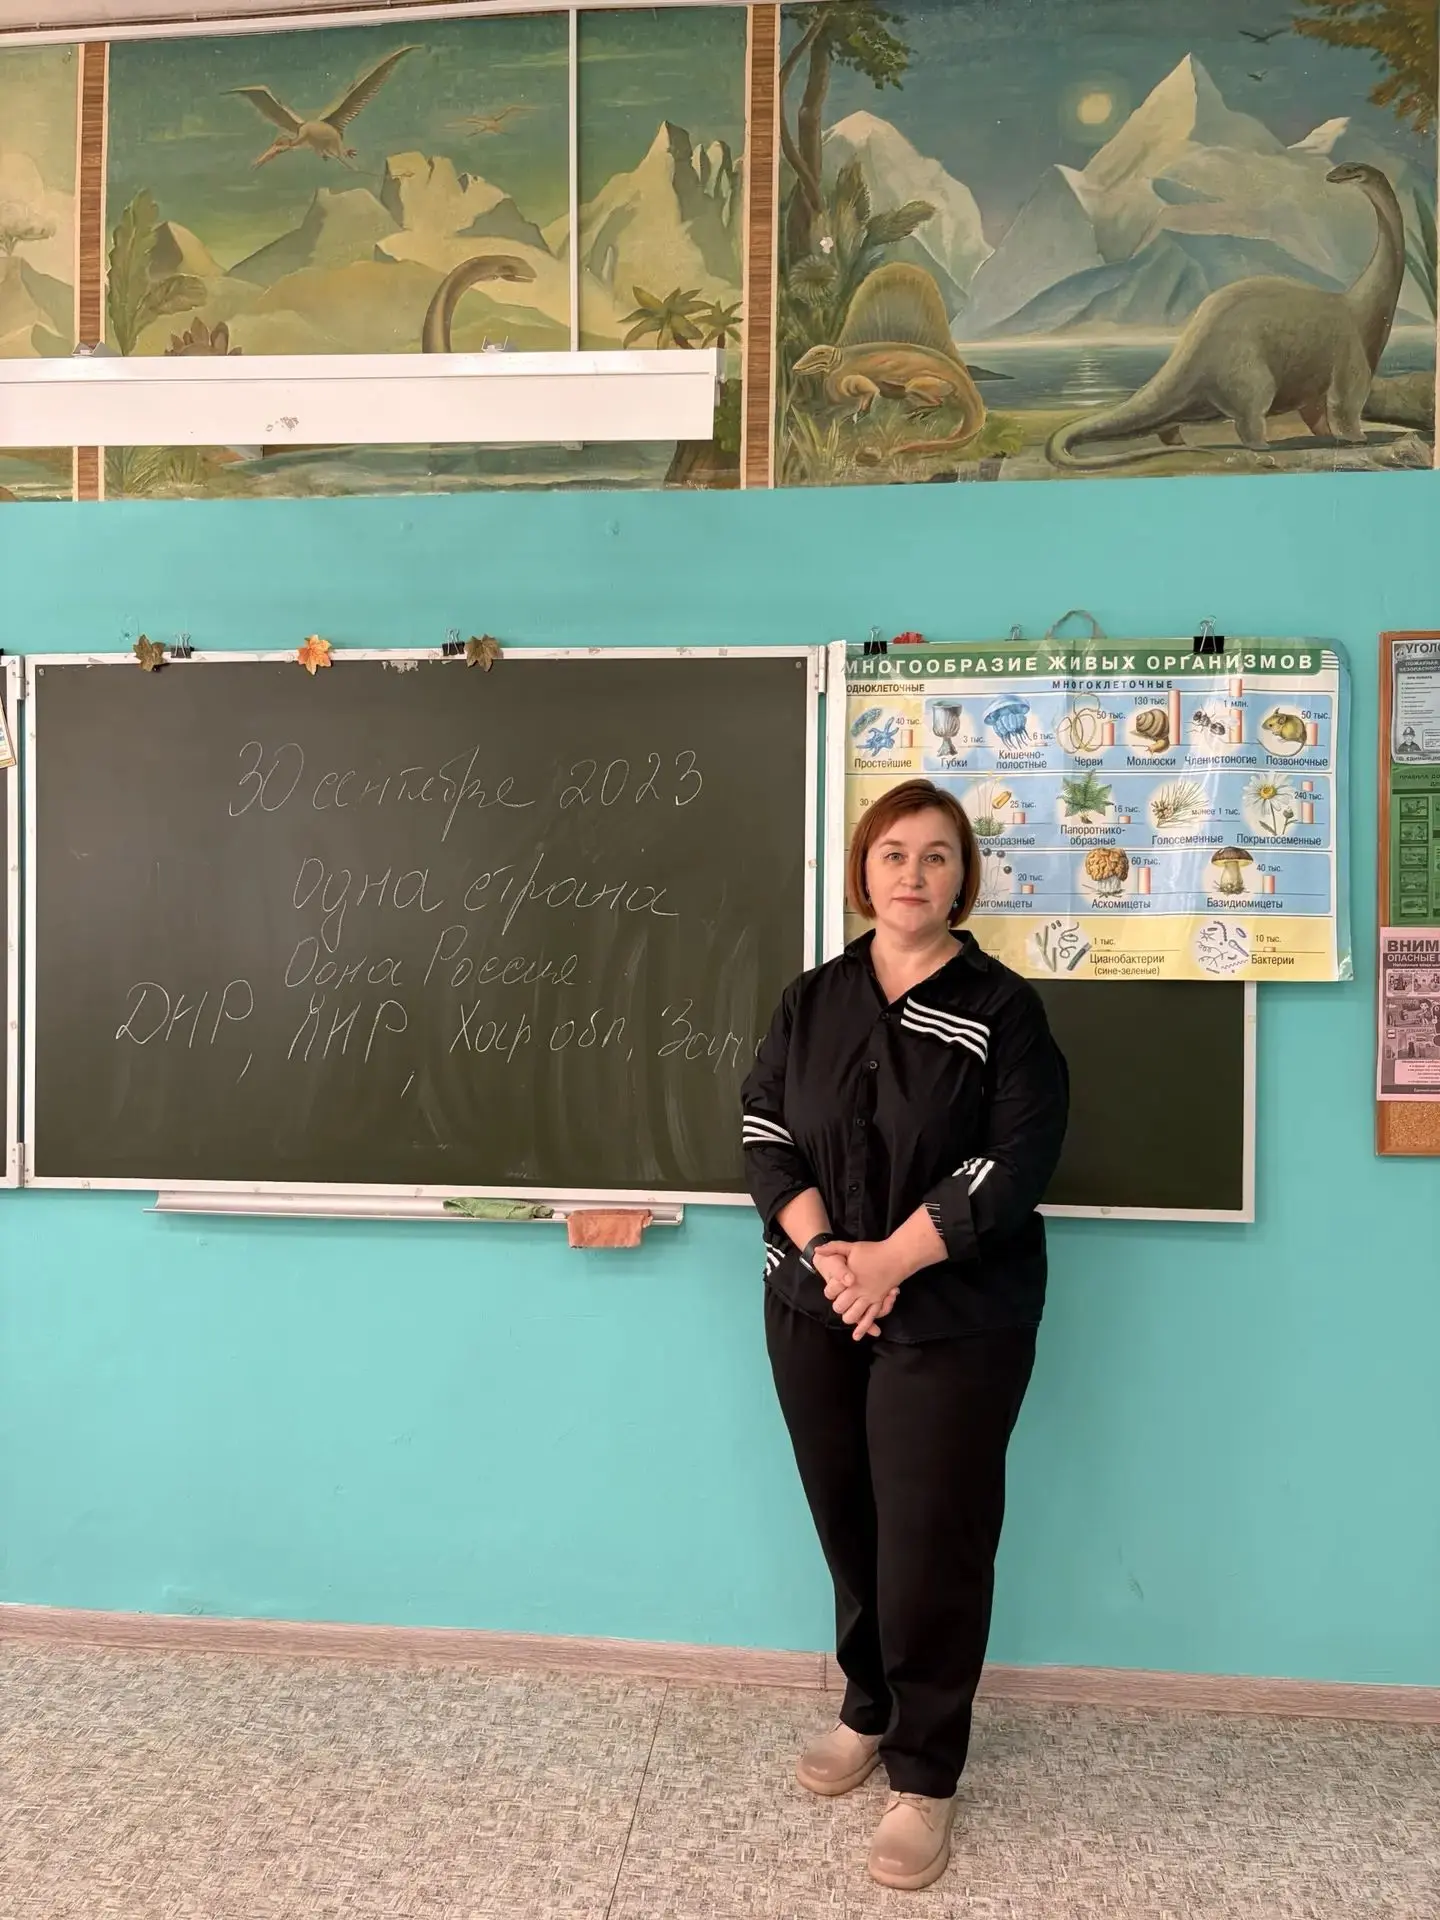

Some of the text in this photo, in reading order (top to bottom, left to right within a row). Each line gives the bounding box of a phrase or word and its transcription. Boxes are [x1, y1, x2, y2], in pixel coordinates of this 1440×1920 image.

[1405, 642, 1440, 654] УГОЛ
[844, 654, 1313, 675] МНОГООБРАЗИЕ ЖИВЫХ ОРГАНИЗМОВ
[846, 683, 925, 694] ОДНОКЛЕТОЧНЫЕ
[1052, 679, 1173, 690] МНОГОКЛЕТОЧНЫЕ
[1134, 696, 1168, 706] 130 тыс.
[1096, 711, 1107, 720] 50
[1301, 711, 1312, 720] 50
[895, 717, 906, 726] 40
[963, 735, 968, 744] 3
[1033, 732, 1038, 741] 6
[999, 749, 1045, 761] Кишечно-
[1184, 754, 1257, 766] Членистоногие
[854, 758, 912, 769] Простейшие
[940, 758, 968, 770] Губки
[996, 760, 1047, 770] полостные
[1074, 757, 1103, 767] Черви
[1126, 756, 1176, 767] Моллюски
[1265, 756, 1329, 767] Позвоночные
[228, 741, 304, 817] 30
[559, 750, 703, 809] 2023
[859, 797, 869, 807] 30
[1294, 792, 1325, 801] 240 тыс.
[1009, 800, 1020, 809] 25
[1114, 804, 1123, 813] 16
[1218, 807, 1223, 816] 1
[1060, 825, 1126, 836] Папоротнико-
[1070, 836, 1116, 847] образные
[1151, 834, 1224, 846] Голосеменные
[1236, 833, 1322, 846] Покрытосеменные
[1131, 856, 1142, 866] 60
[1256, 864, 1266, 872] 40
[1017, 873, 1028, 882] 20
[975, 898, 1033, 910] Зигомицеты
[1091, 898, 1151, 910] Аскомицеты
[1206, 897, 1284, 909] Базидиомицеты
[1094, 937, 1098, 945] 1
[1255, 934, 1265, 943] 10
[1387, 939, 1439, 952] ВНИМ
[1089, 953, 1165, 965] Цианобактерии
[1251, 953, 1295, 966] Бактерии
[1387, 953, 1436, 962] ОПАСНЫЕ
[1094, 966, 1161, 977] (сине-зеленые)
